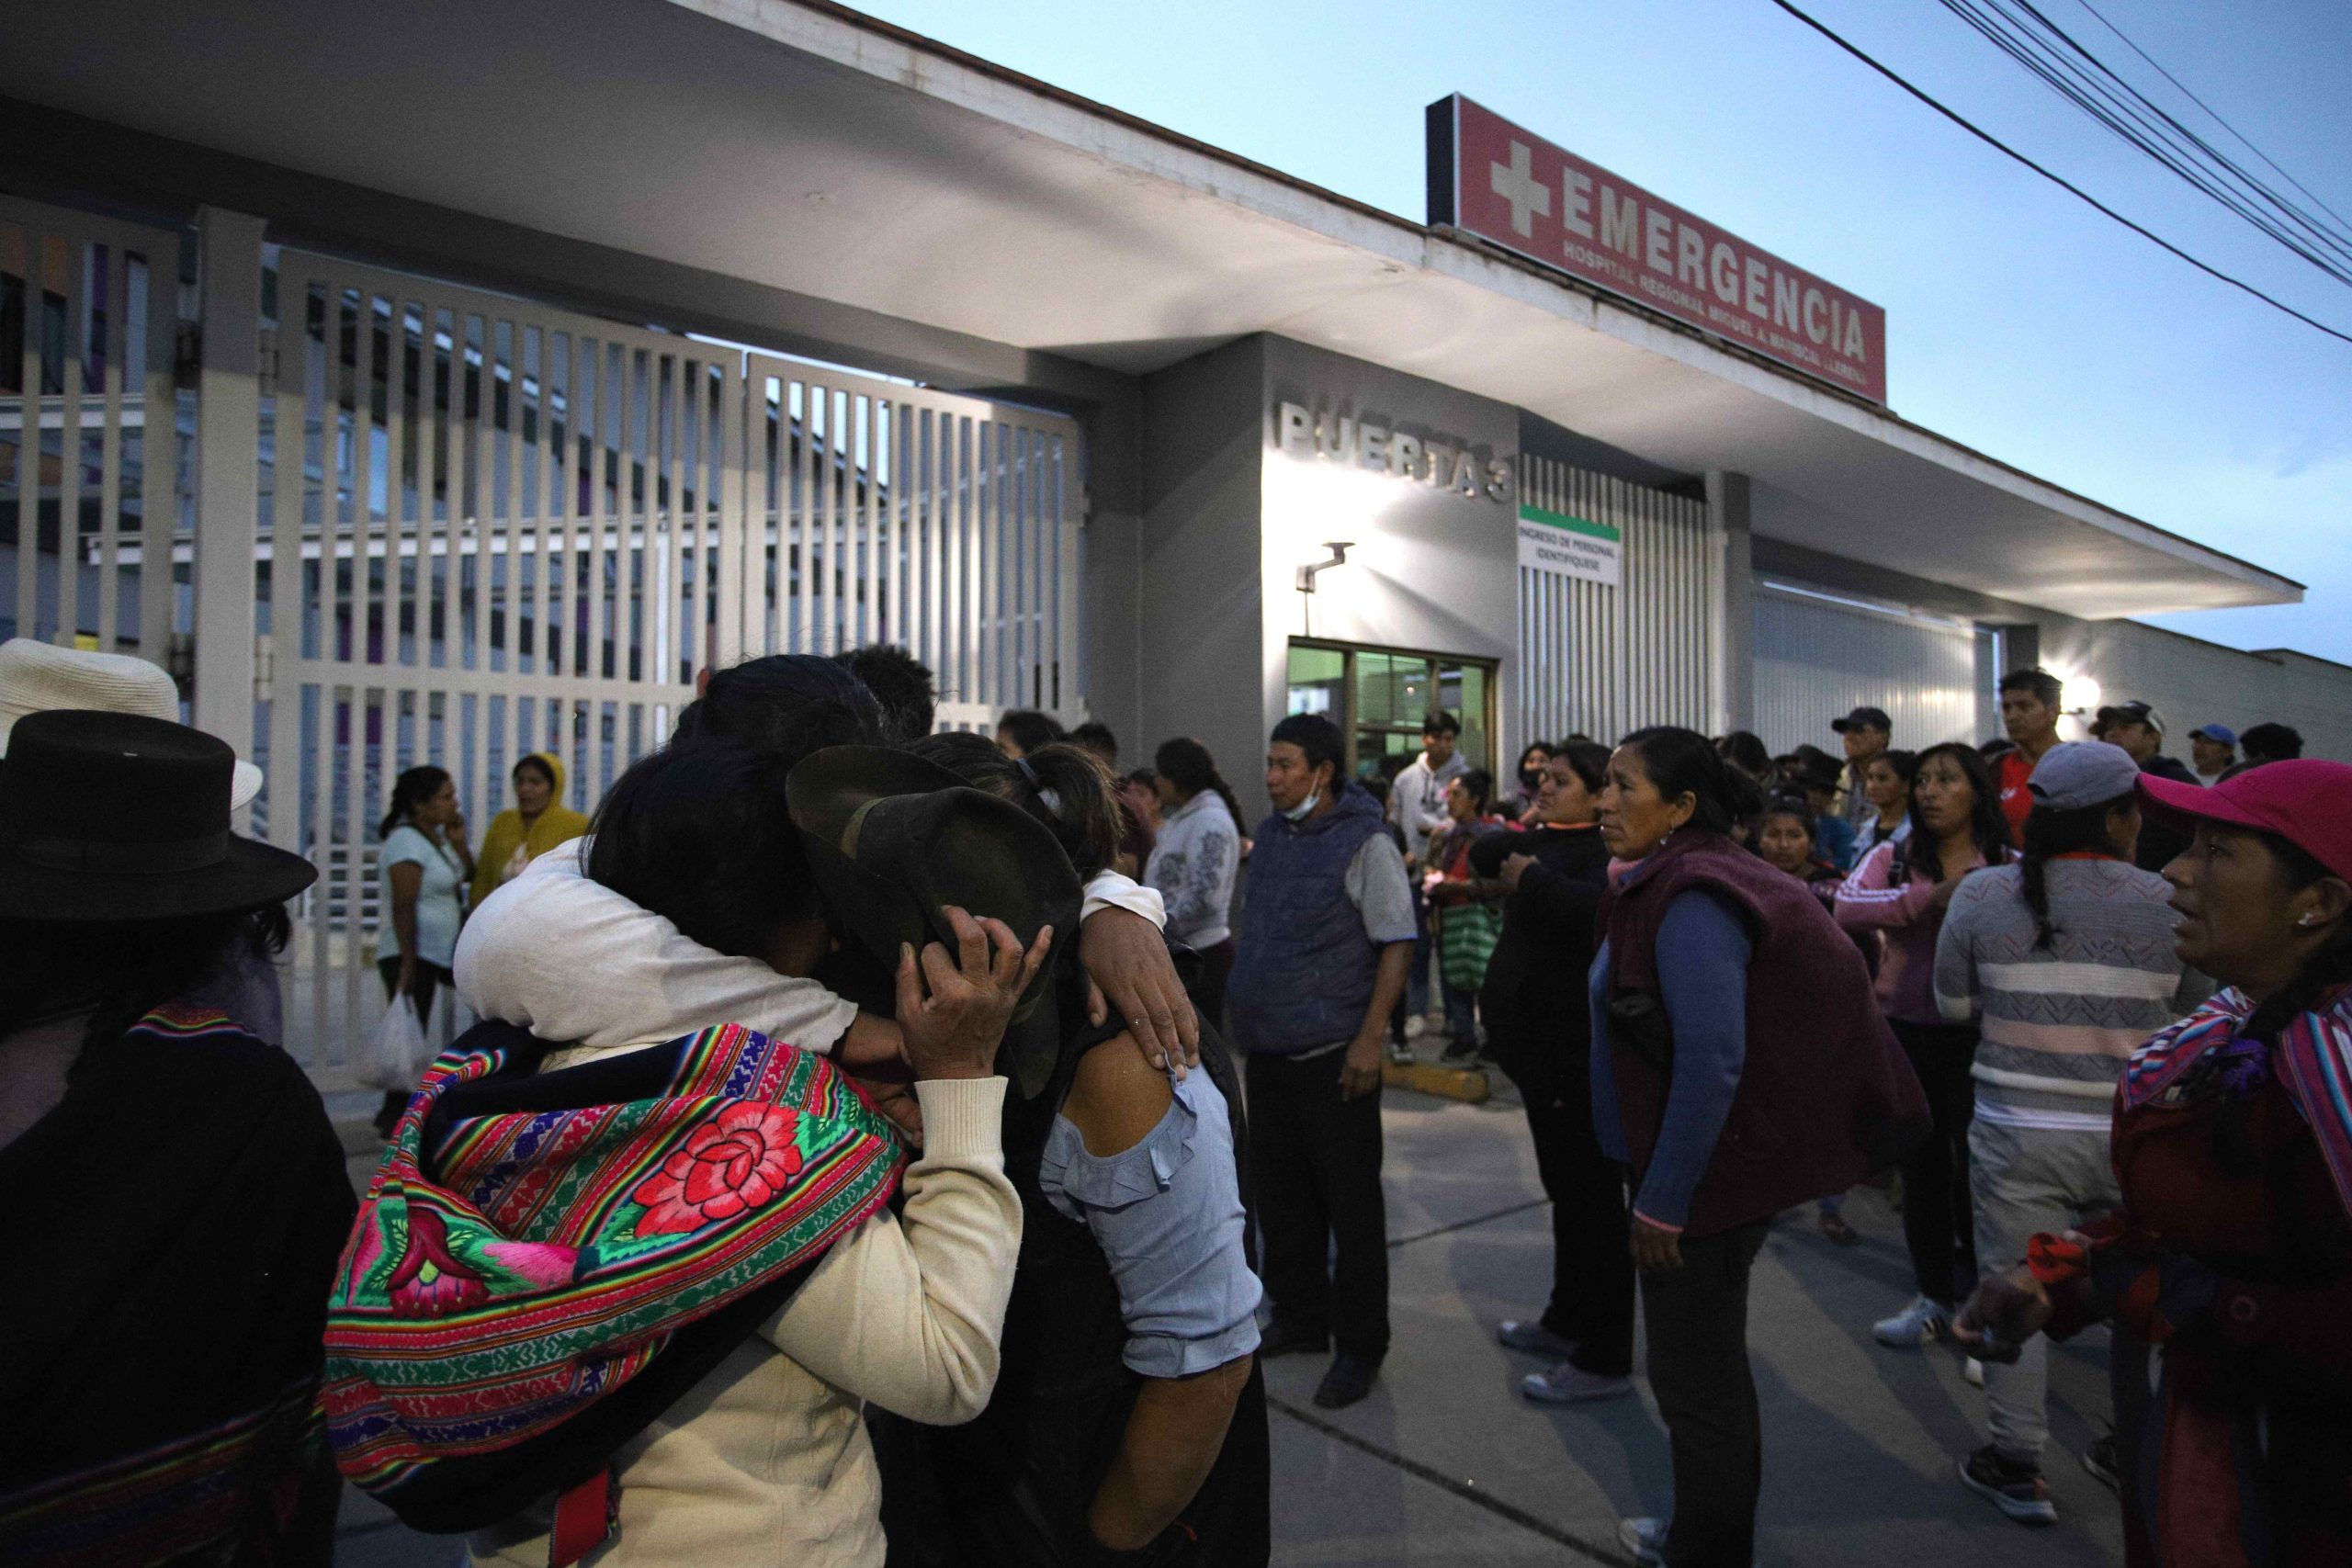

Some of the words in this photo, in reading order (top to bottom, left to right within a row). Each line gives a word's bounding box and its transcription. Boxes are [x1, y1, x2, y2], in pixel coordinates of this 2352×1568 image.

[1563, 166, 1866, 363] EMERGENCIA
[1563, 241, 1635, 286] HOSPITAL
[1640, 274, 1705, 316] REGIONAL
[1708, 305, 1754, 337] MIGUEL
[1519, 526, 1557, 545] INGRESO
[1559, 536, 1570, 548] DE
[1572, 538, 1614, 558] PERSONAL
